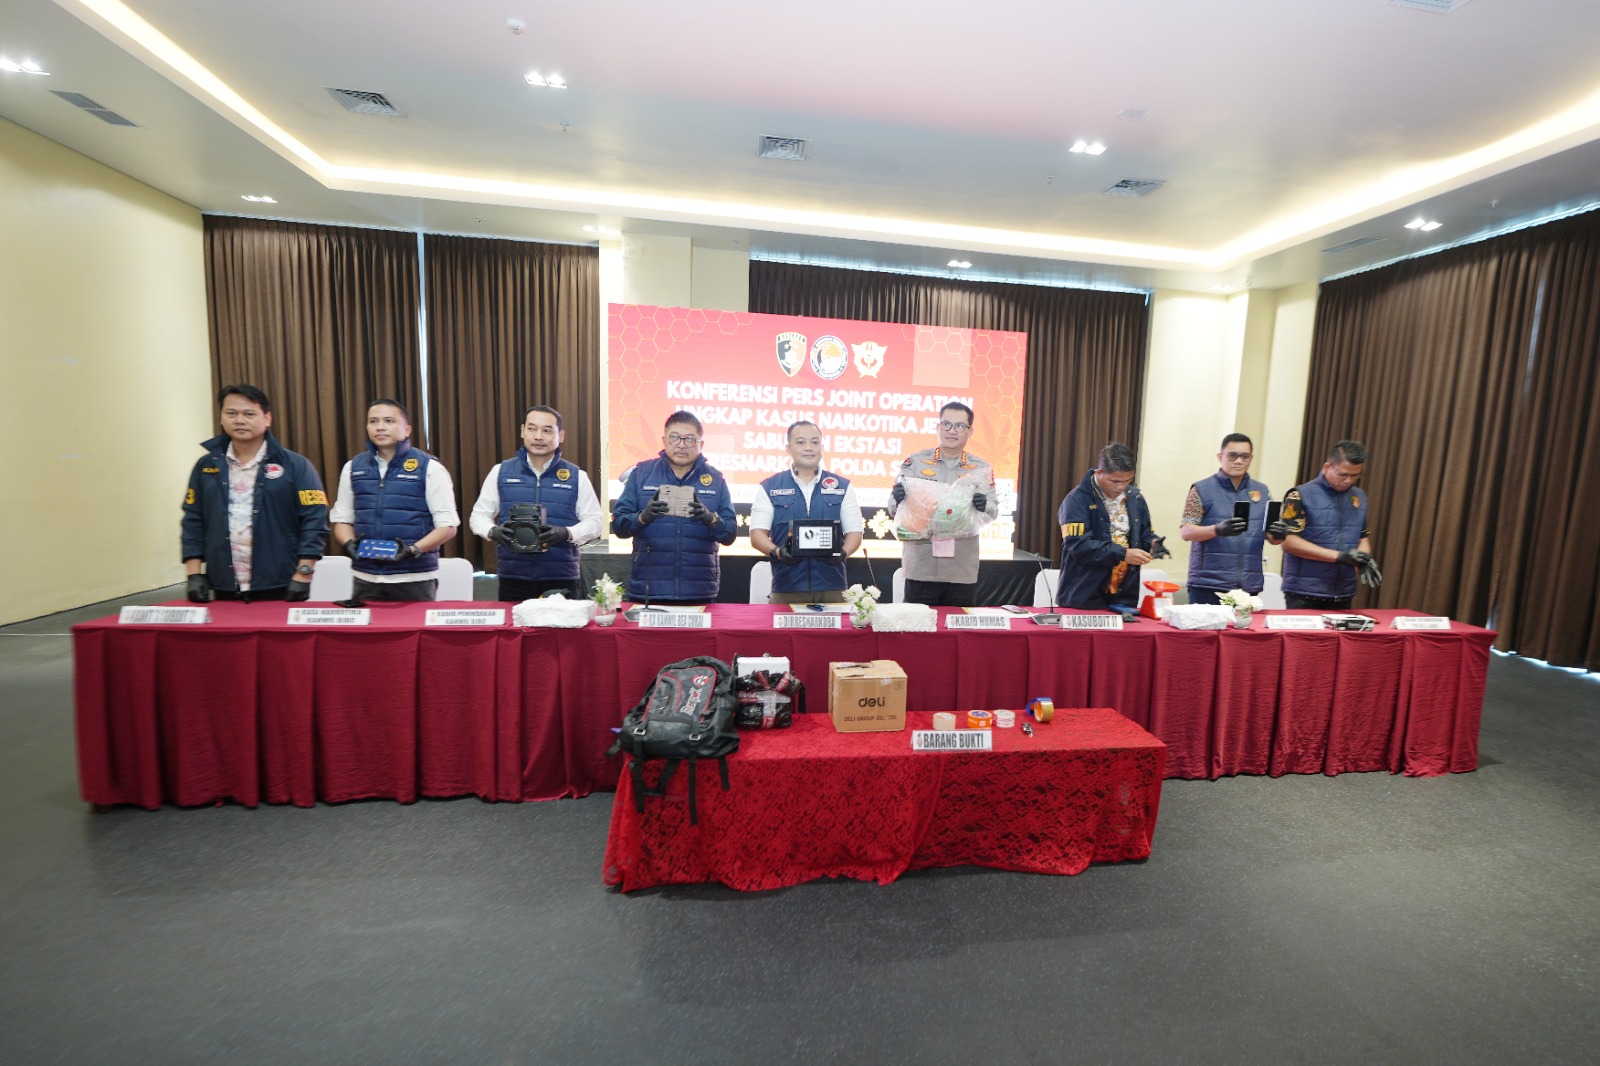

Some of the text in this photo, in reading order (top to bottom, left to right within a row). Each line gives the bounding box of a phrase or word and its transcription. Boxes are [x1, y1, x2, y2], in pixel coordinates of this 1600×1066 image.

[667, 380, 778, 404] KONFERENSI
[781, 386, 824, 406] PERS
[827, 390, 876, 409] JOINT
[756, 408, 815, 427] KASUS
[818, 411, 919, 434] NARKOTIKA
[743, 431, 789, 450] SABU
[835, 436, 902, 454] EKSTASI
[831, 458, 886, 476] POLDA
[955, 615, 1006, 627] KABID HUMAS
[1072, 615, 1110, 628] KASUBDIT
[858, 696, 886, 708] deli
[923, 732, 984, 748] BARANG BUKTI
